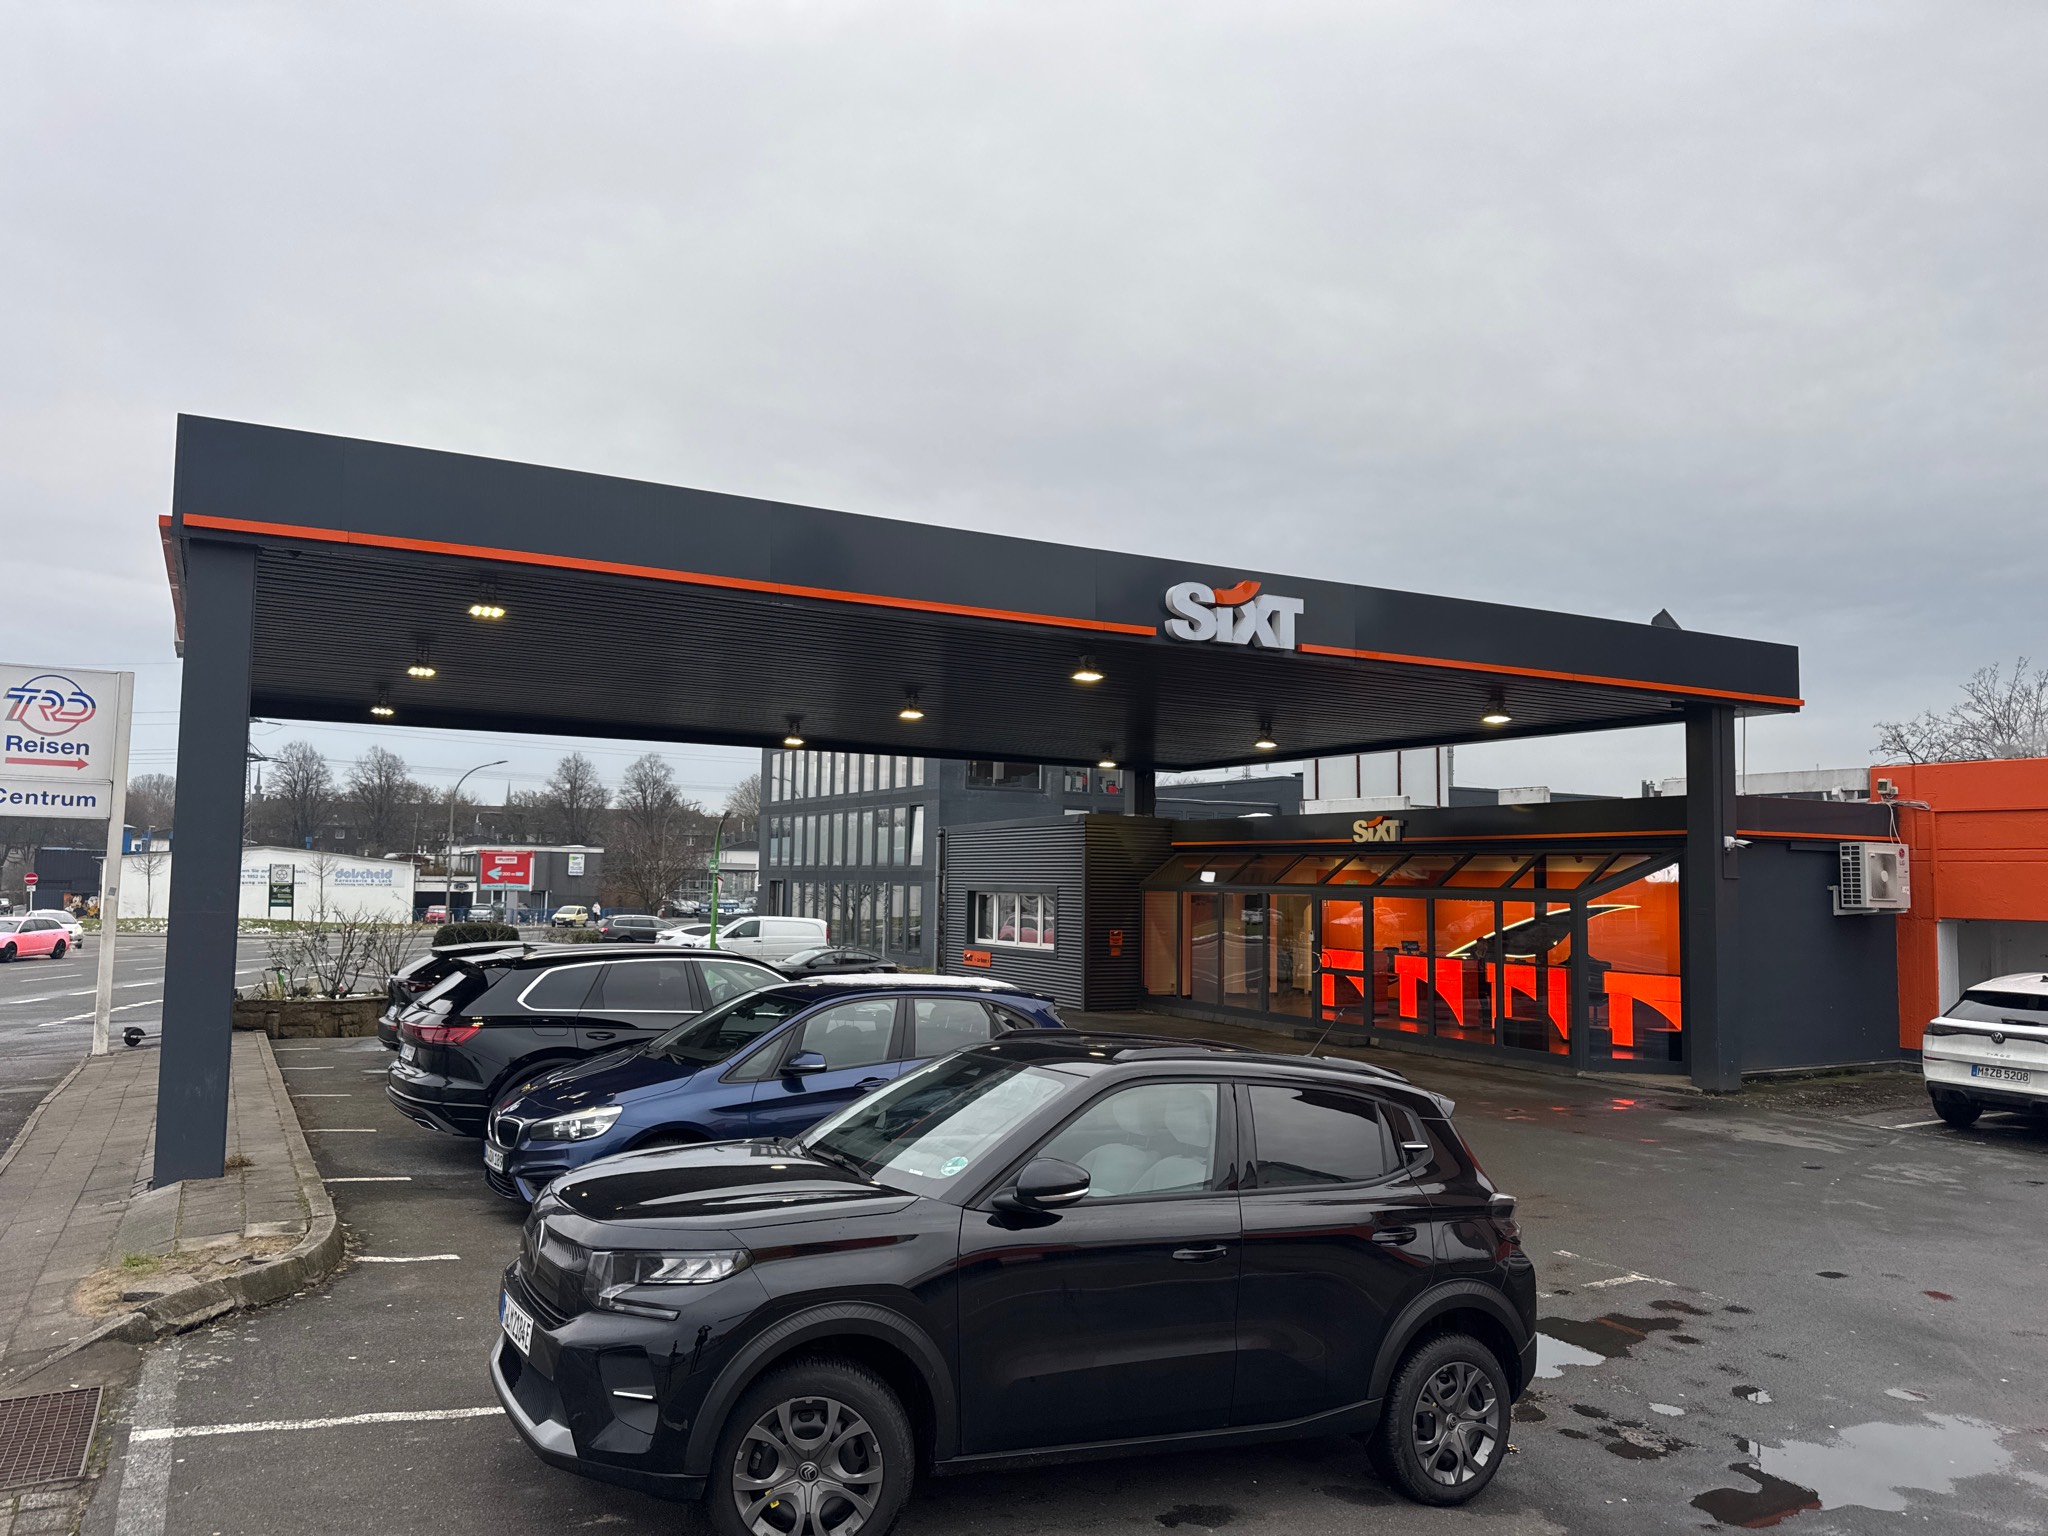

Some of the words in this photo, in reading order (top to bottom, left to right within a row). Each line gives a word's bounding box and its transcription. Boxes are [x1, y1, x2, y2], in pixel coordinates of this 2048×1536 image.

[1164, 580, 1304, 650] SIXT
[5, 735, 90, 756] Reisen
[1353, 816, 1401, 843] SIXT
[1989, 1068, 2002, 1078] ZB
[2003, 1070, 2029, 1082] 5208
